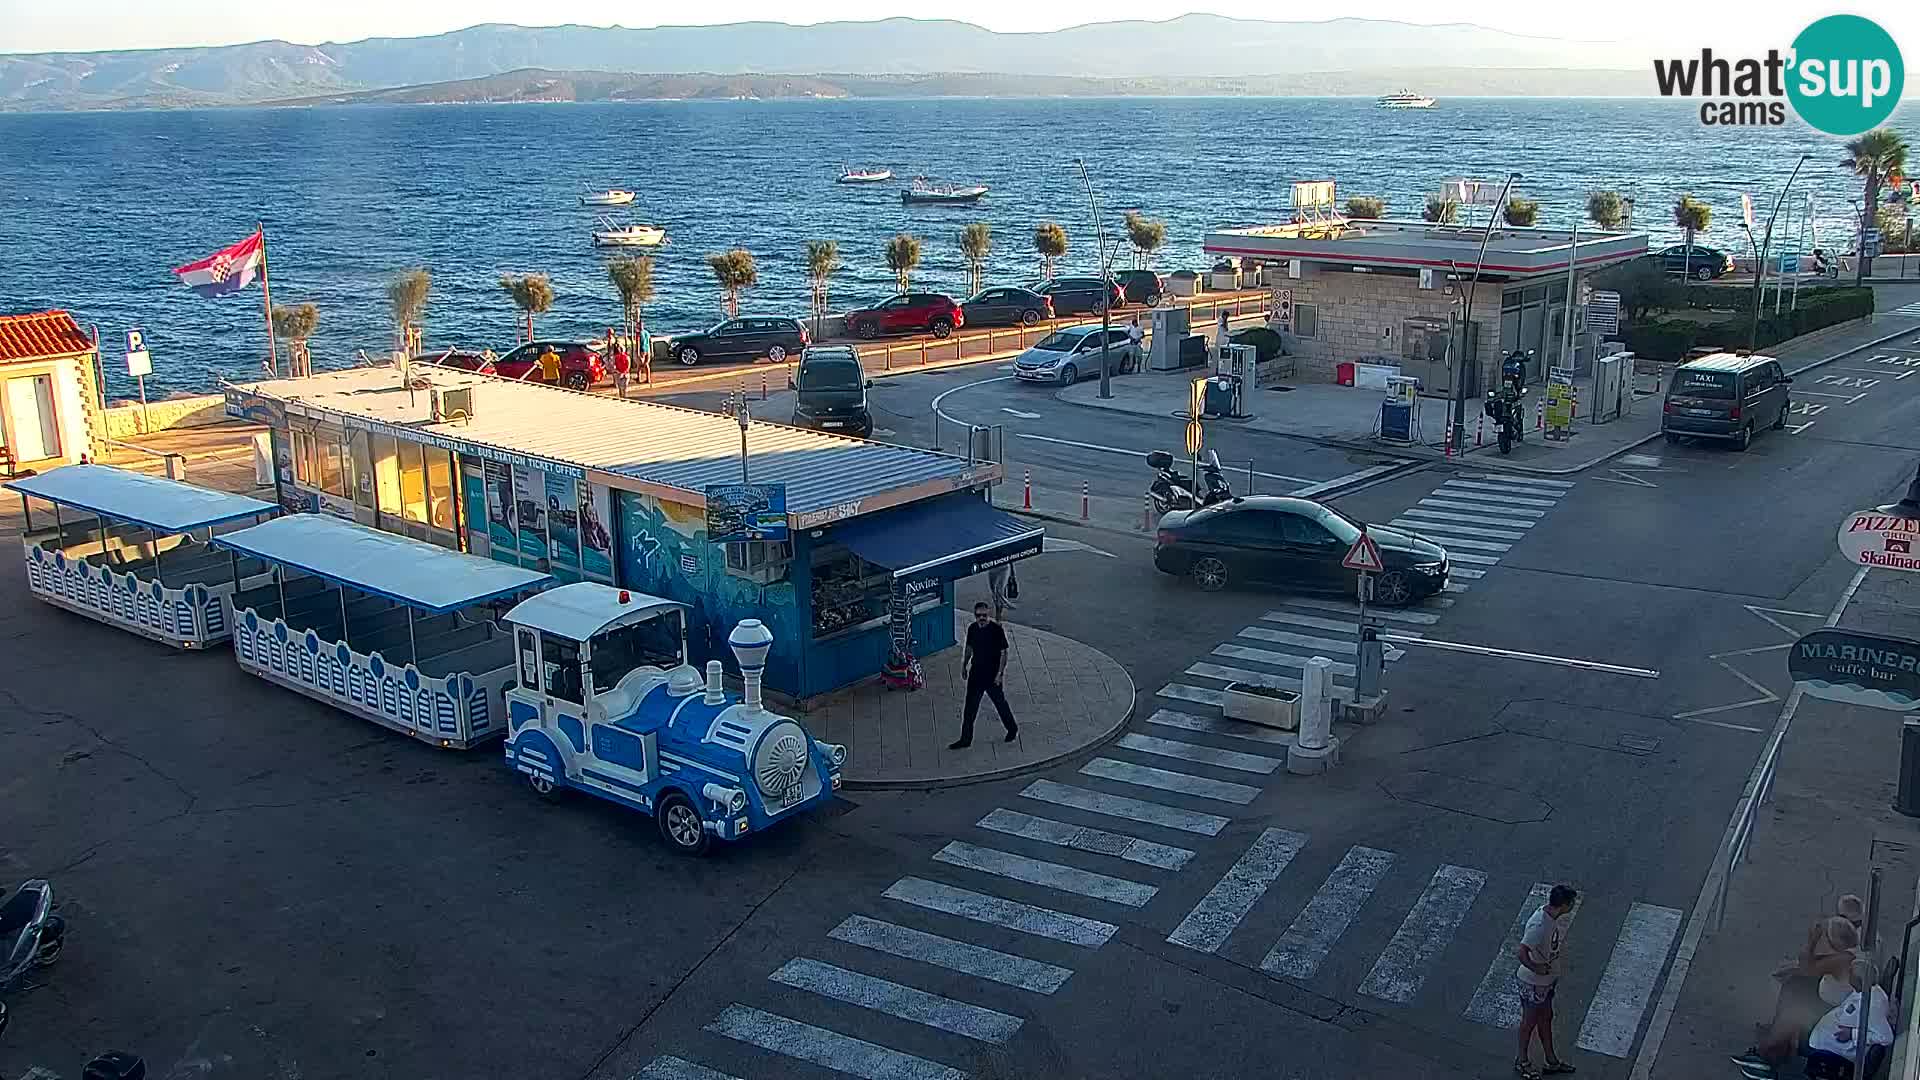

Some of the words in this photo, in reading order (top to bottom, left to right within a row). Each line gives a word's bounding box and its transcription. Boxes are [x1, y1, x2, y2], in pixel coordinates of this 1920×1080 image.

[128, 331, 142, 351] P
[1695, 374, 1714, 382] TAXI
[435, 436, 468, 453] POSTAJA
[477, 446, 493, 458] BUS
[494, 450, 526, 466] STATION
[528, 458, 554, 473] TICKET
[555, 463, 582, 478] OFFICE
[1848, 516, 1920, 534] PIZZE
[905, 577, 939, 594] Novine
[1801, 643, 1920, 674] MARINER
[1871, 666, 1897, 681] bar
